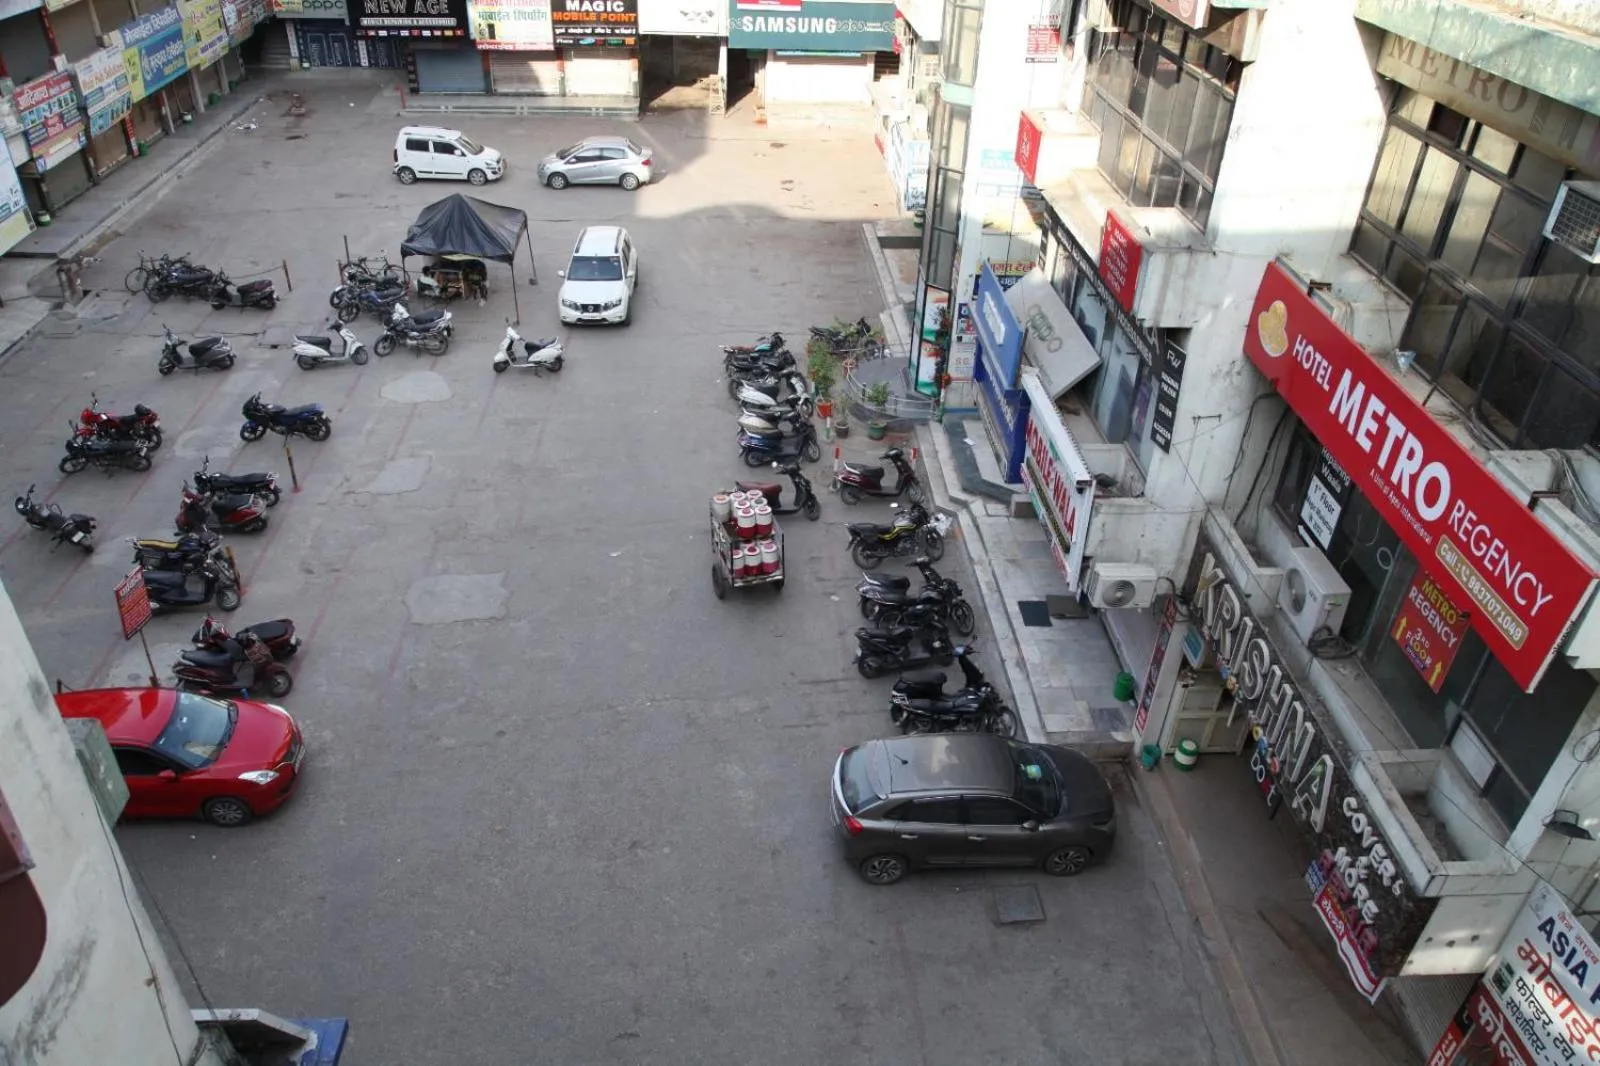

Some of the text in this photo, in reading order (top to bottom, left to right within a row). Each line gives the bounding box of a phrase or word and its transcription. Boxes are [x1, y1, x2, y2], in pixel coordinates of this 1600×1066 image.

[364, 0, 449, 14] NEW AGE
[553, 12, 636, 21] MOBILE POINT
[566, 0, 624, 12] MAGIC
[743, 16, 837, 33] SAMSUNG
[1293, 334, 1553, 618] HOTEL METRO REGENCY
[1439, 540, 1457, 569] Call
[1408, 586, 1458, 648] REGENCY
[1420, 578, 1458, 625] METRO
[1194, 552, 1334, 834] KRISHNA
[1334, 846, 1379, 925] MORE
[1538, 916, 1588, 989] ASIA
